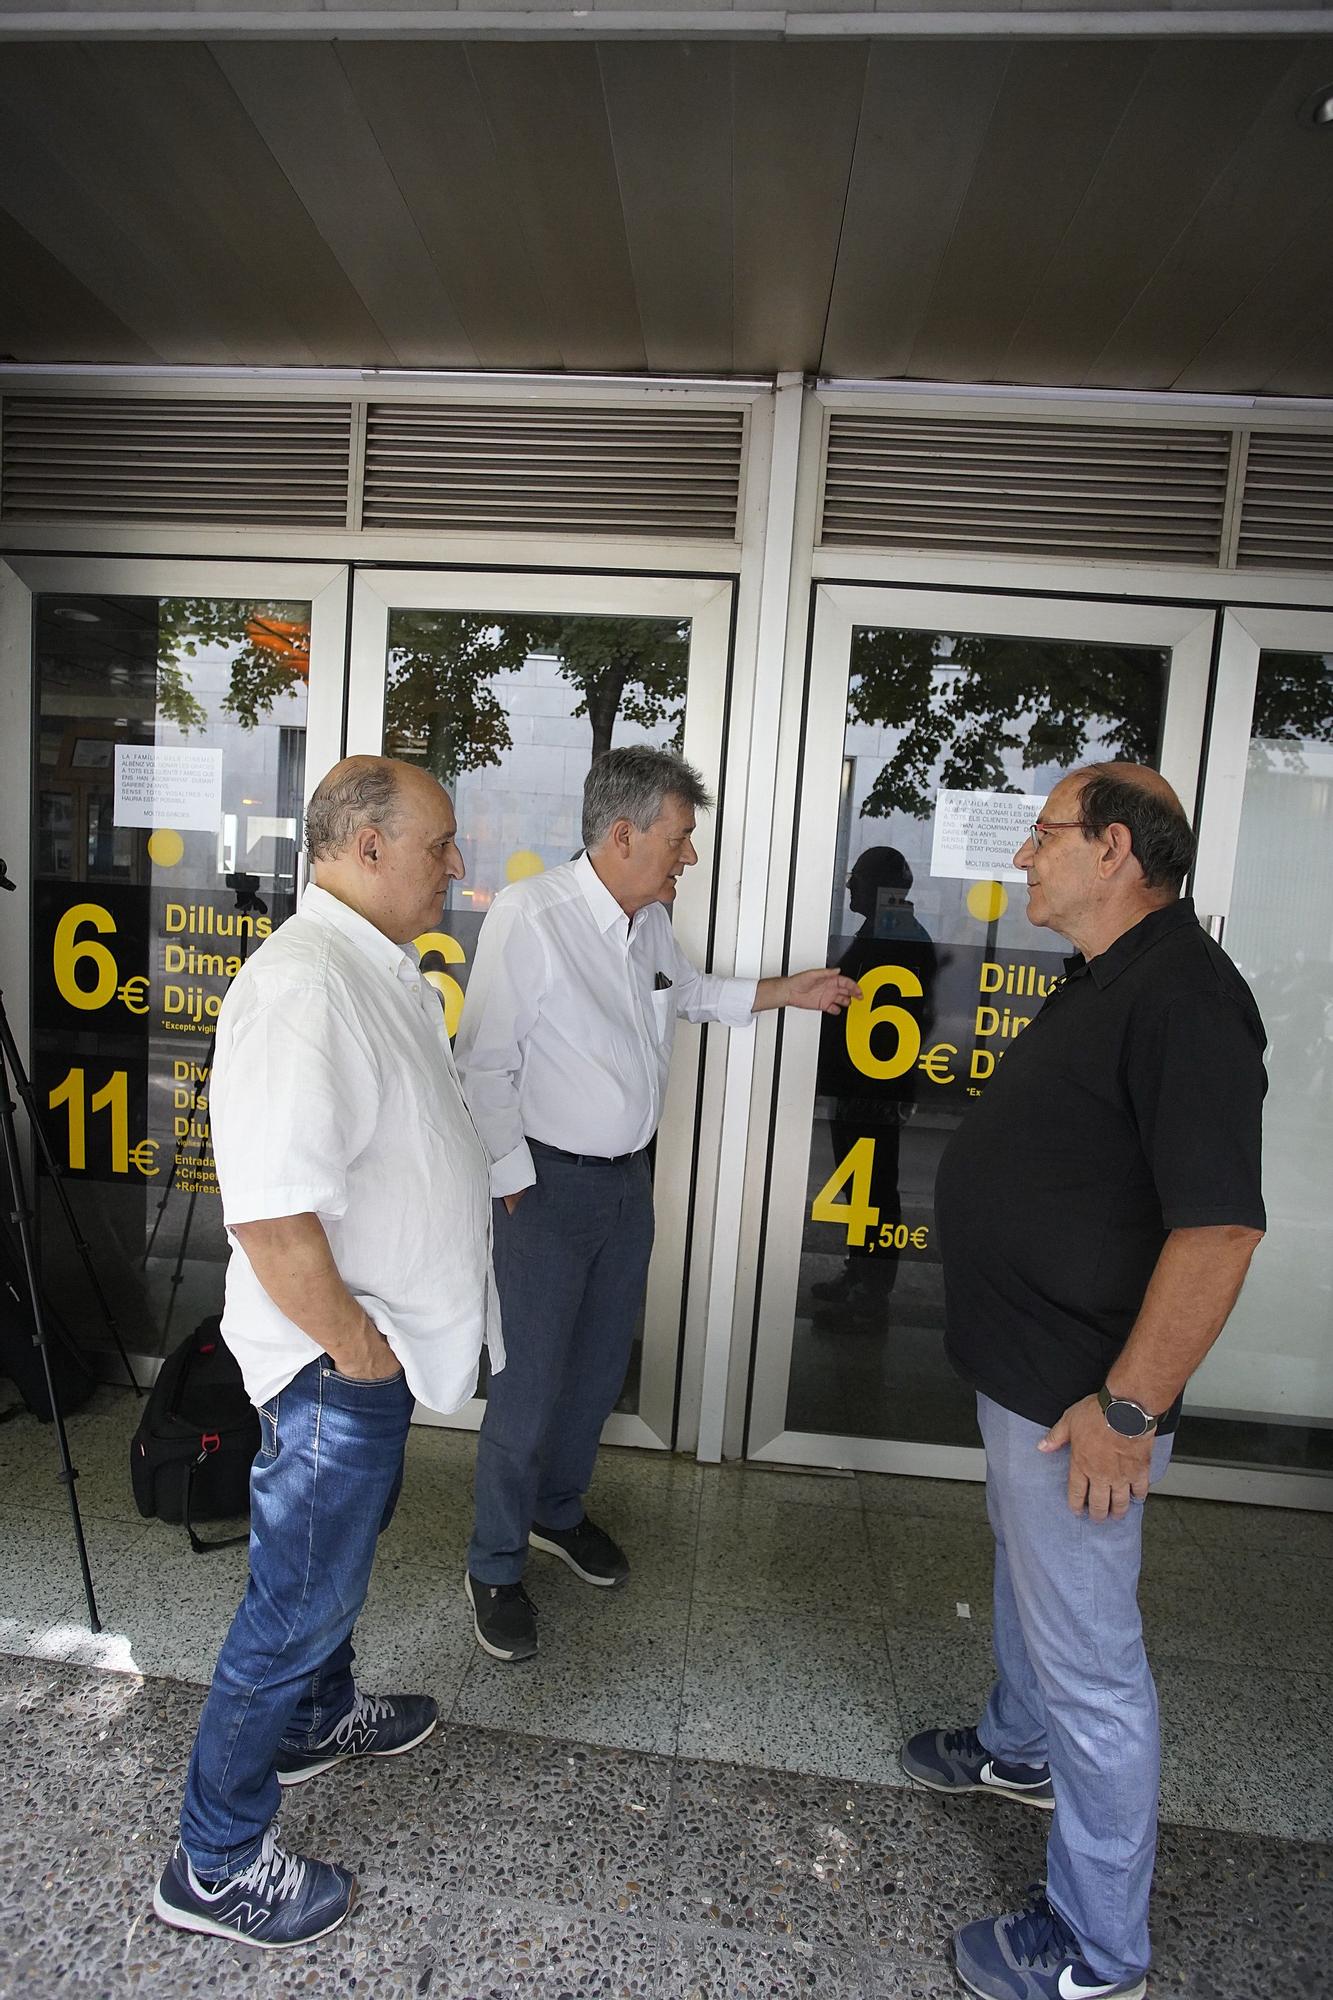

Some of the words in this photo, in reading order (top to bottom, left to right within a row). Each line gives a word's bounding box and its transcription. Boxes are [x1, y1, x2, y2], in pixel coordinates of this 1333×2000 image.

[982, 816, 1009, 824] CLIENTS
[986, 808, 1008, 816] DONAR
[978, 824, 1019, 832] ACOMPANYAT
[165, 903, 273, 938] Dilluns
[53, 903, 150, 1014] 6€
[164, 944, 244, 977] Dima
[979, 962, 1060, 998] Dillu
[163, 984, 223, 1022] Dijo
[197, 1023, 217, 1035] vigili
[846, 964, 958, 1084] 6€
[174, 1060, 211, 1082] Div
[174, 1088, 209, 1111] Dis
[49, 1067, 160, 1176] 11€
[174, 1117, 209, 1139] Diu
[175, 1181, 221, 1193] +Refresc
